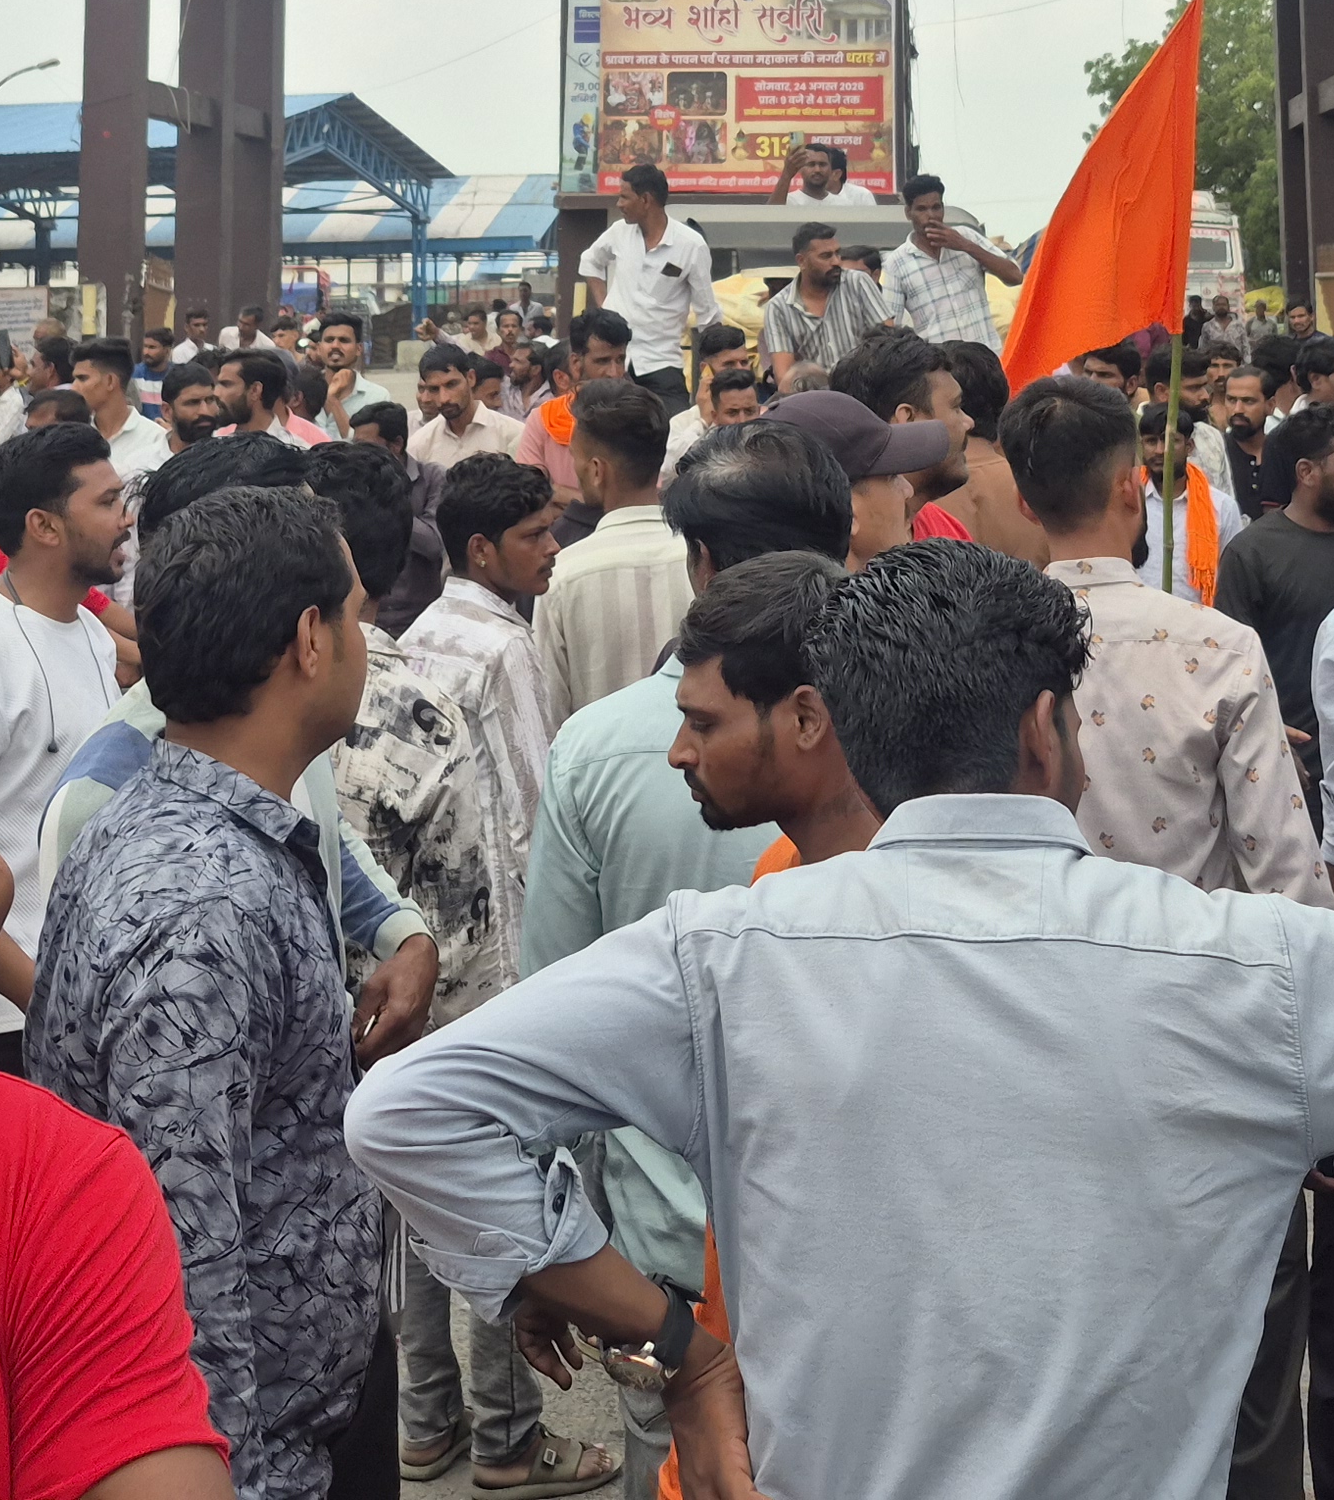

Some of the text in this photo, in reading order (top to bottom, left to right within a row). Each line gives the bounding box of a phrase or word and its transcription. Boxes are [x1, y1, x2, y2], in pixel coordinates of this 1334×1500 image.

[622, 5, 674, 31] भव्य
[636, 54, 657, 65] मास
[659, 52, 670, 65] के
[671, 54, 698, 65] पावन
[716, 54, 730, 65] पर
[732, 54, 754, 65] बाबा
[755, 54, 798, 66] महाकाल
[800, 51, 814, 65] की
[816, 51, 844, 65] नगरी
[573, 82, 601, 92] 78,00
[794, 81, 807, 91] 24
[808, 81, 839, 91] अगस्त
[816, 95, 824, 105] 4
[842, 95, 861, 105] तक
